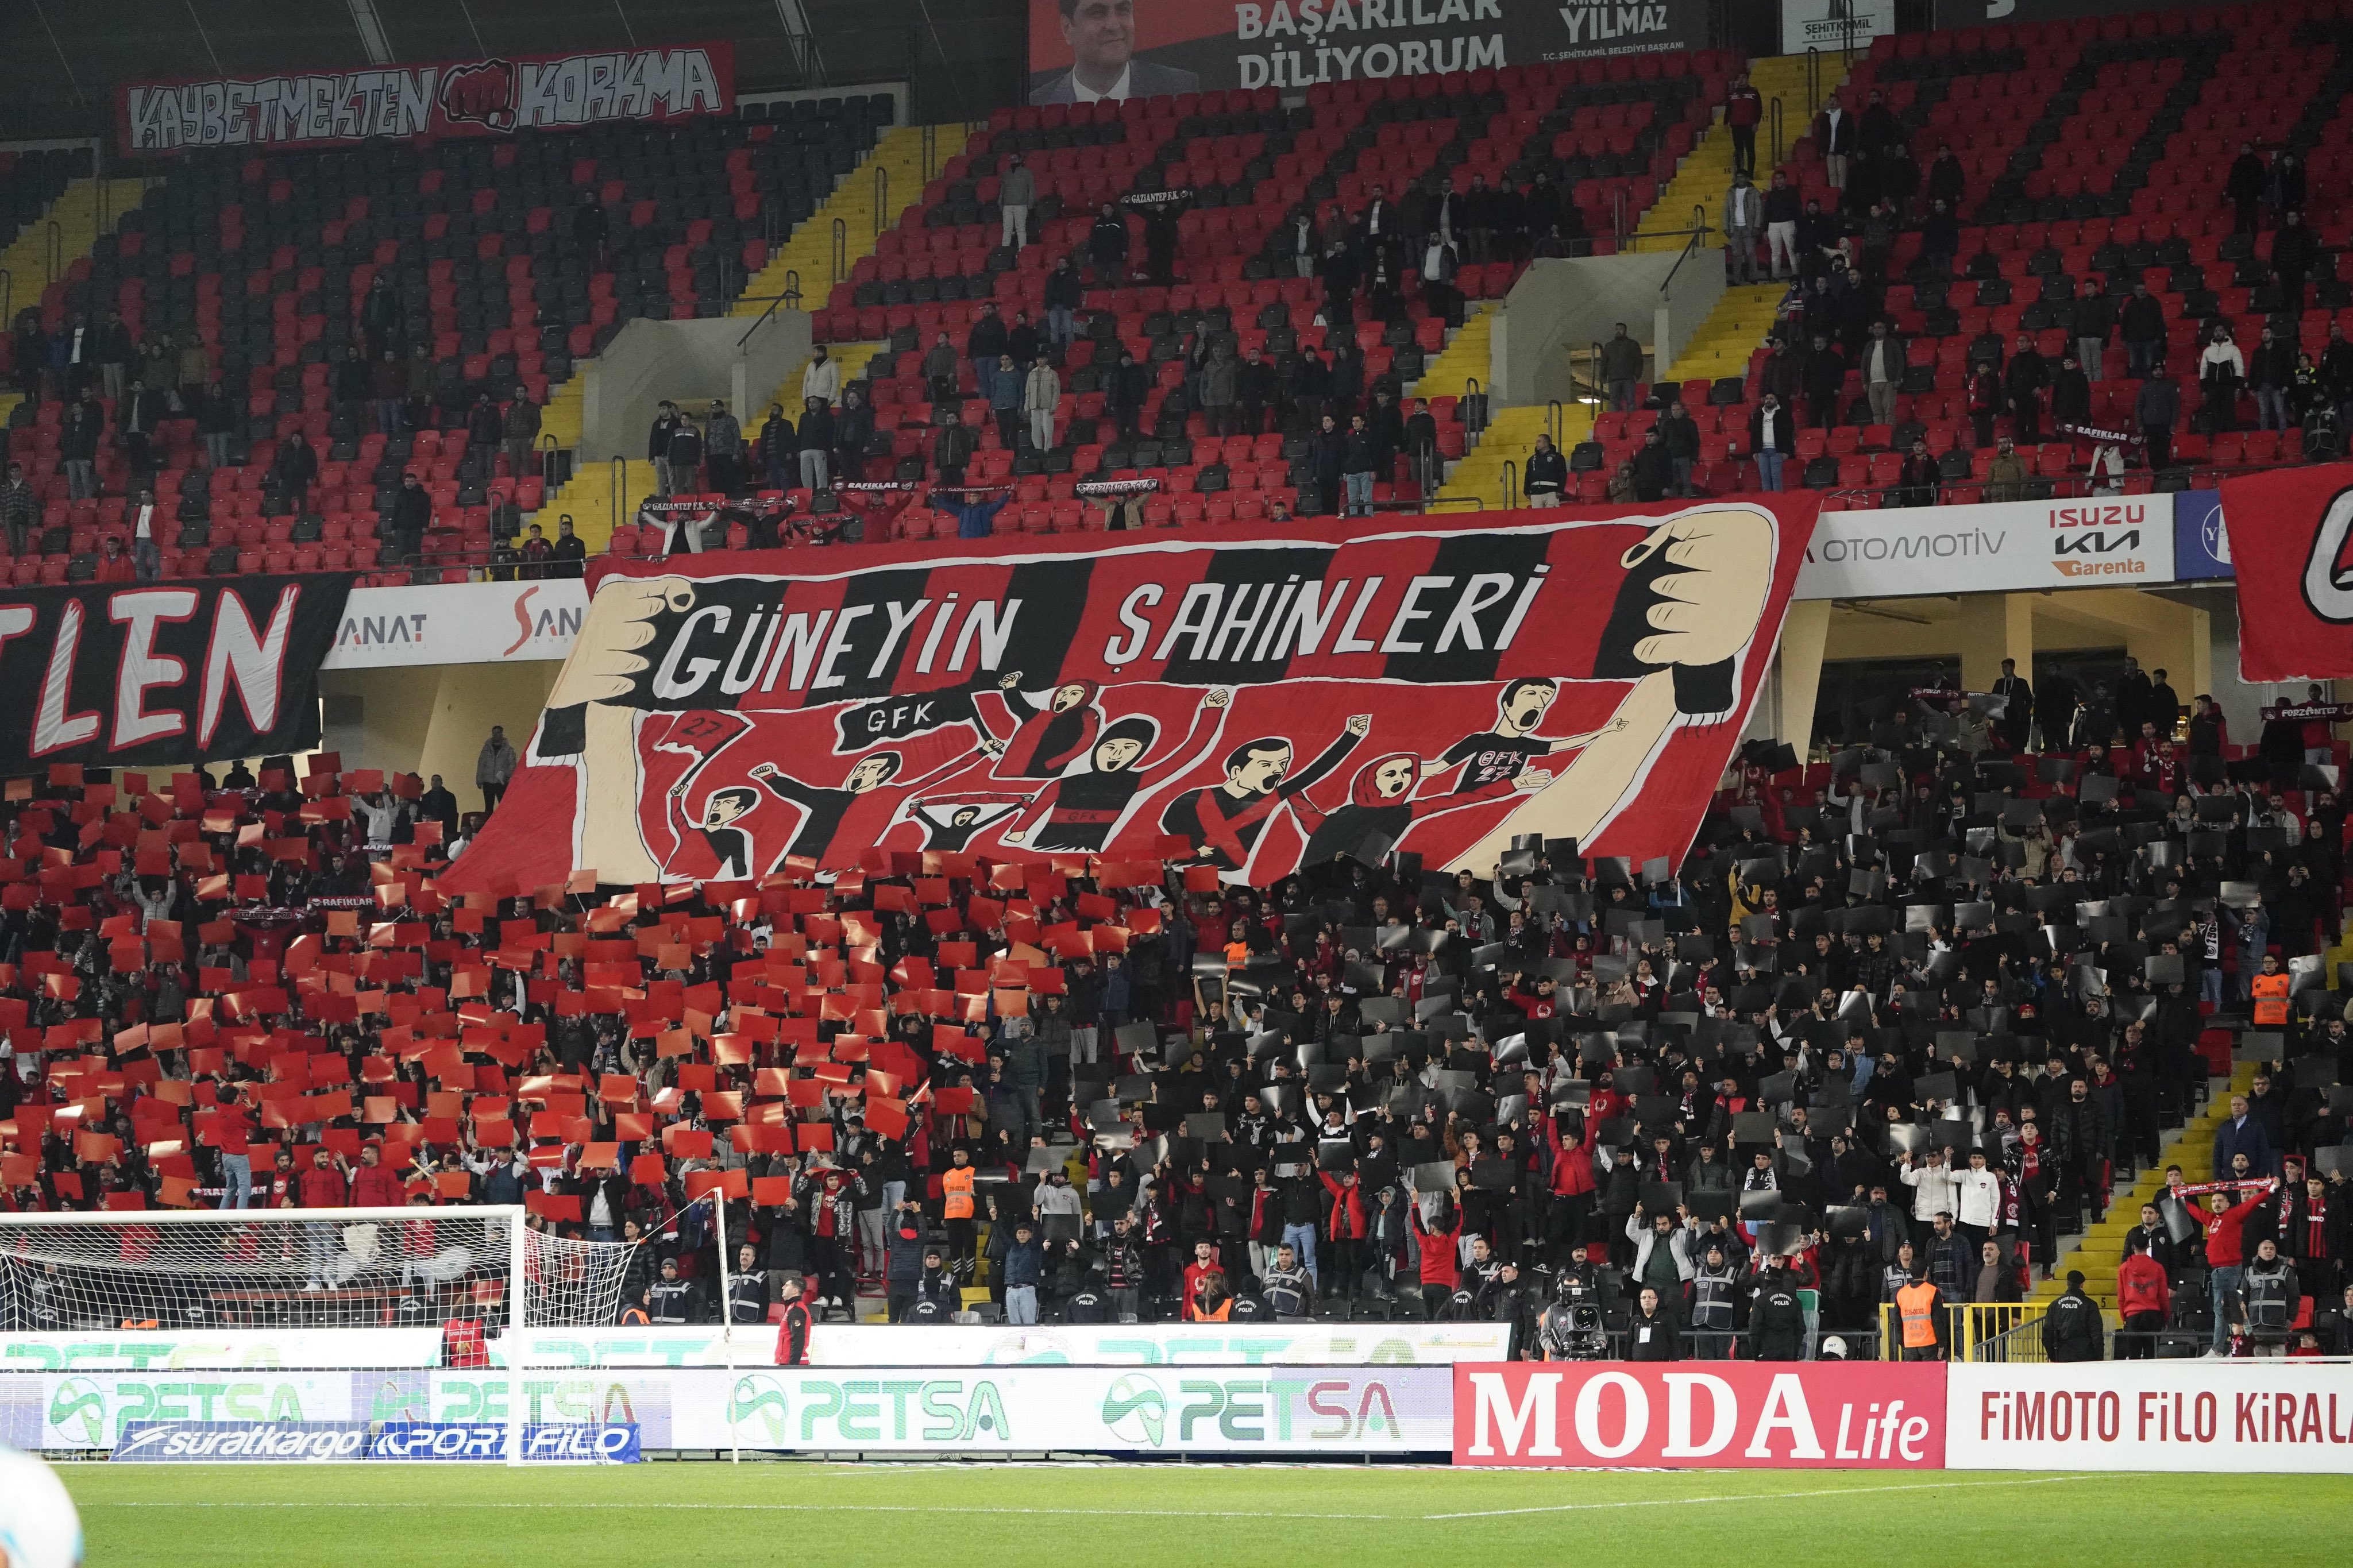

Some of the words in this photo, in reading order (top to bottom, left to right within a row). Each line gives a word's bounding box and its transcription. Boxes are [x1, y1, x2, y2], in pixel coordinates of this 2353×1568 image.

[1236, 0, 1502, 44] BAŞARILAR
[1559, 4, 1667, 44] YILMAZ
[1237, 34, 1507, 90] DİLİYORUM
[128, 67, 438, 149] KAYBETMEKTEN
[518, 48, 722, 126] KORKMA
[2077, 426, 2128, 441] RAFIKLAR
[2050, 505, 2144, 528] ISUZU
[2055, 530, 2139, 555] KIA
[2071, 558, 2146, 576] Garenta
[331, 615, 427, 647] ANAT
[1103, 563, 1551, 674] ŞAHİNLERİ
[651, 591, 1023, 698] GÜNEYİN
[681, 717, 723, 737] 27
[867, 700, 936, 732] GFK
[1474, 765, 1513, 783] 27
[1478, 750, 1523, 767] GFK
[322, 898, 373, 907] RAFIKLAR
[2101, 1296, 2107, 1308] 5
[117, 1383, 303, 1430] PETSA
[801, 1381, 1010, 1440] PETSA
[1180, 1380, 1402, 1440] PETSA
[1468, 1373, 1826, 1458] MODA
[1835, 1399, 1930, 1462] Life
